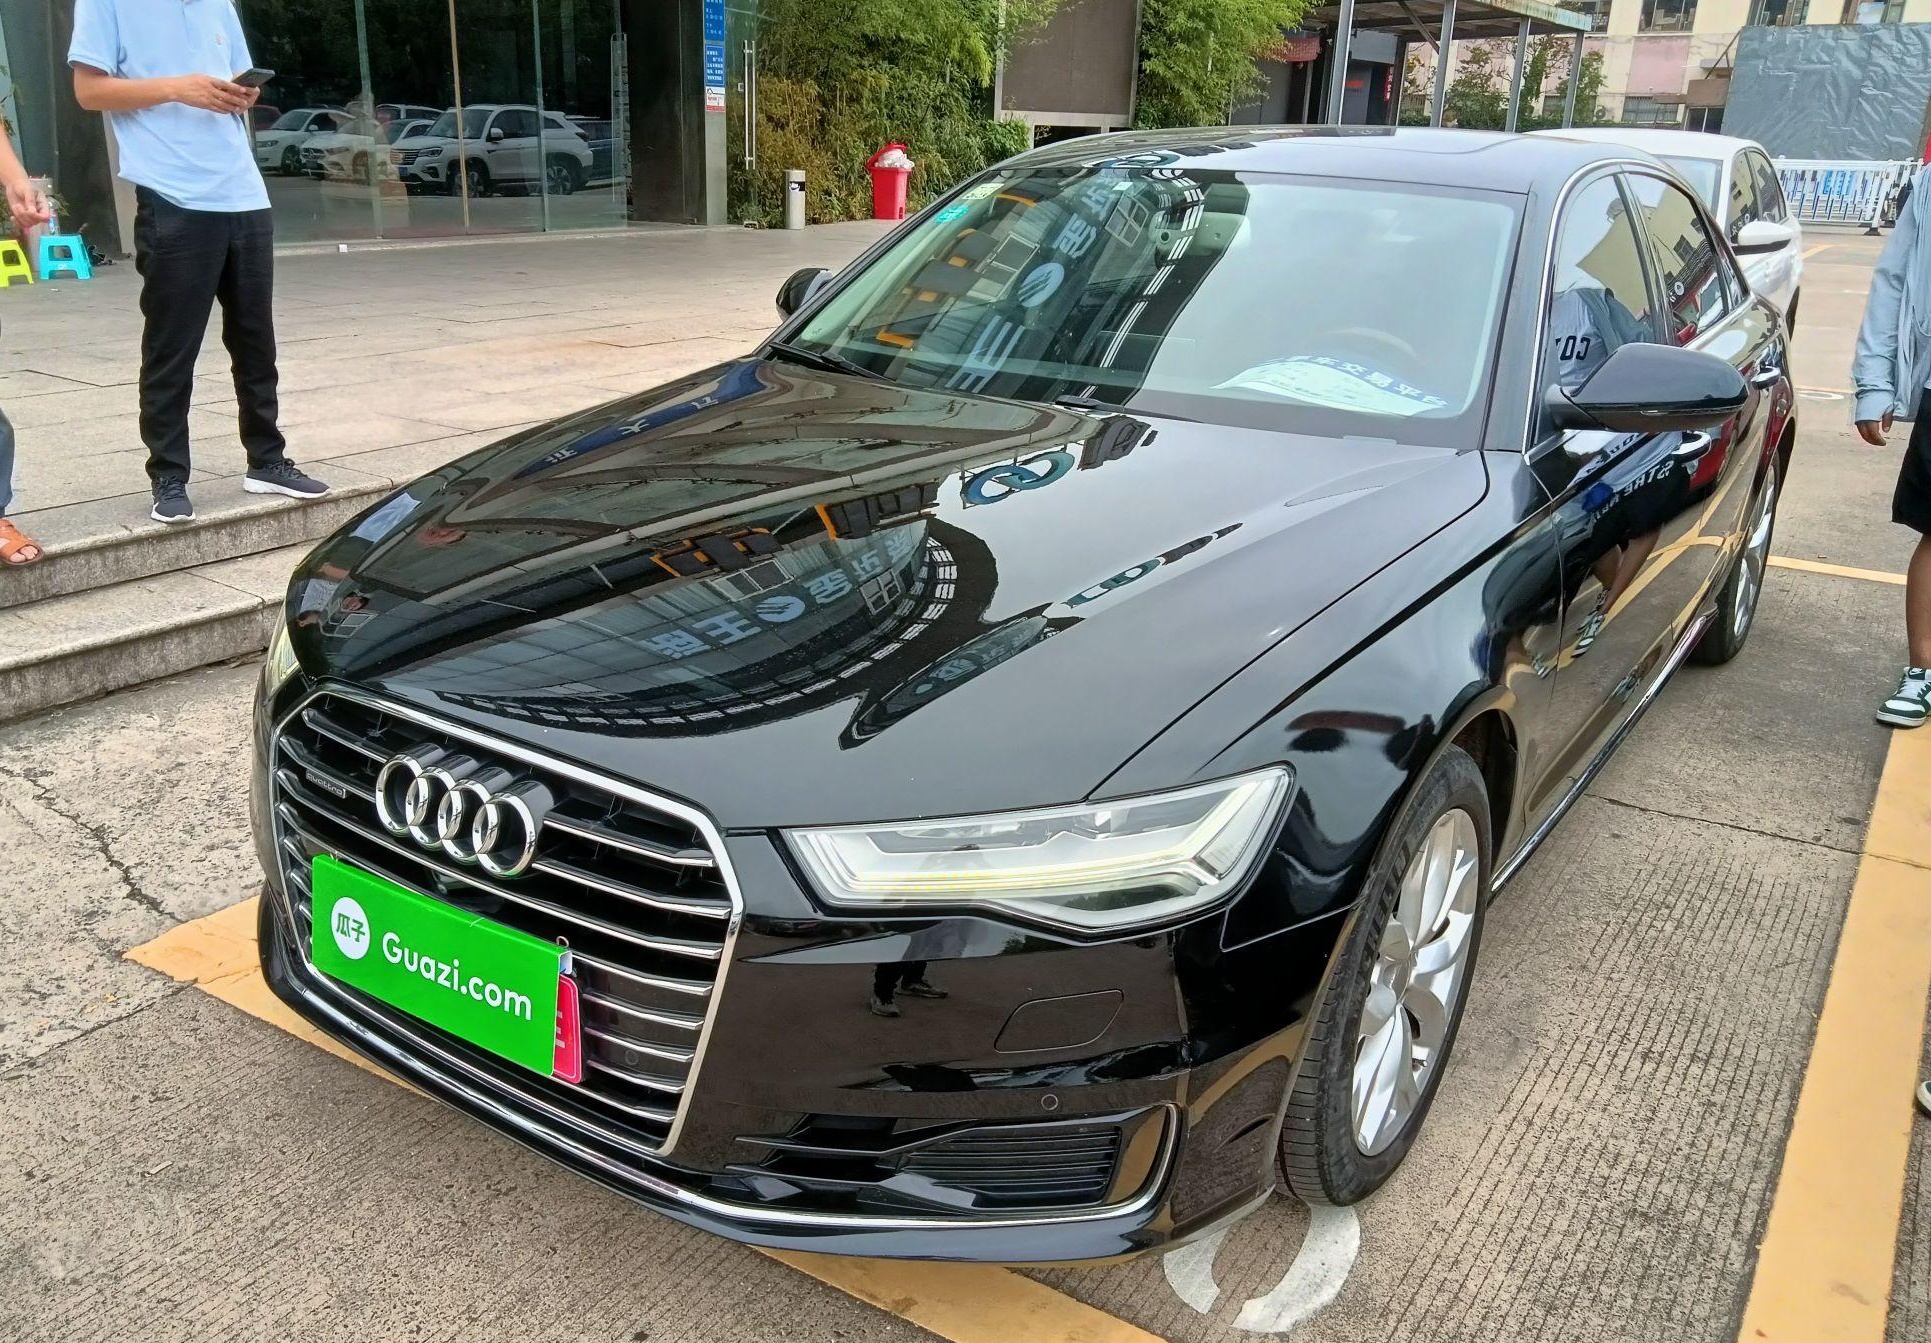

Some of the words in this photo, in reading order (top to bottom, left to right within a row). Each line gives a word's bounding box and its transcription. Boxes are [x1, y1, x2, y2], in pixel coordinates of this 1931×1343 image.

[306, 772, 344, 797] quattro
[335, 912, 367, 943] 瓜子
[381, 931, 532, 1021] Guazi.com
